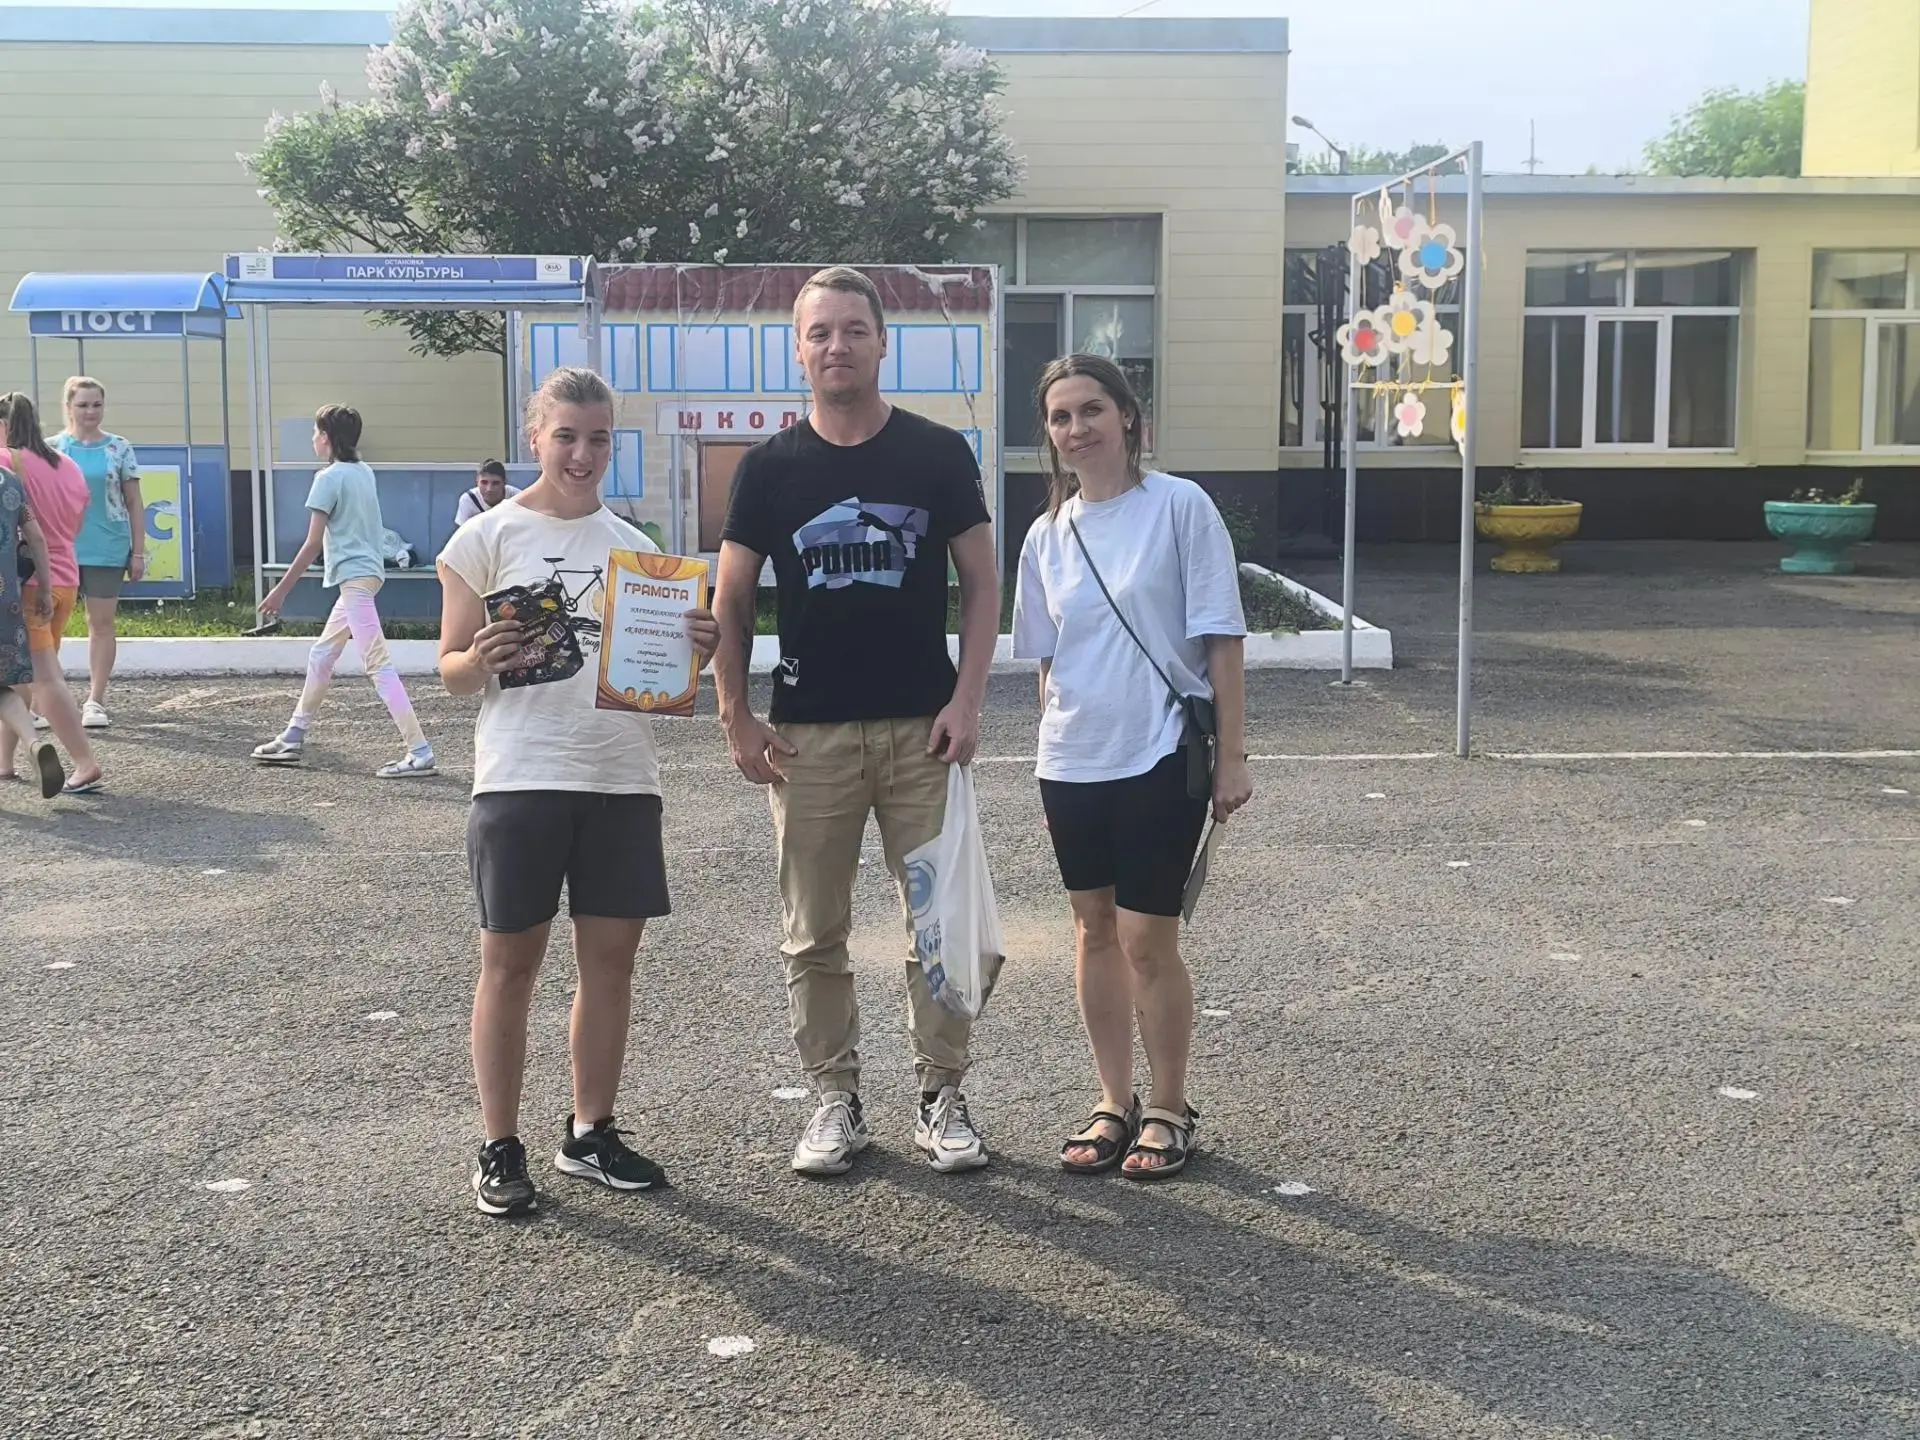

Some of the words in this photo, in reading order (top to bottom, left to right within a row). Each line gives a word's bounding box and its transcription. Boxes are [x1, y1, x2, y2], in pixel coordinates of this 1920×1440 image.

[346, 266, 384, 278] ПАРК
[388, 266, 464, 279] КУЛЬТУРЫ
[60, 311, 155, 332] ПОСТ
[678, 411, 797, 429] ШКОЛ
[802, 540, 891, 576] PUMA
[624, 582, 689, 600] ГРАМОТА
